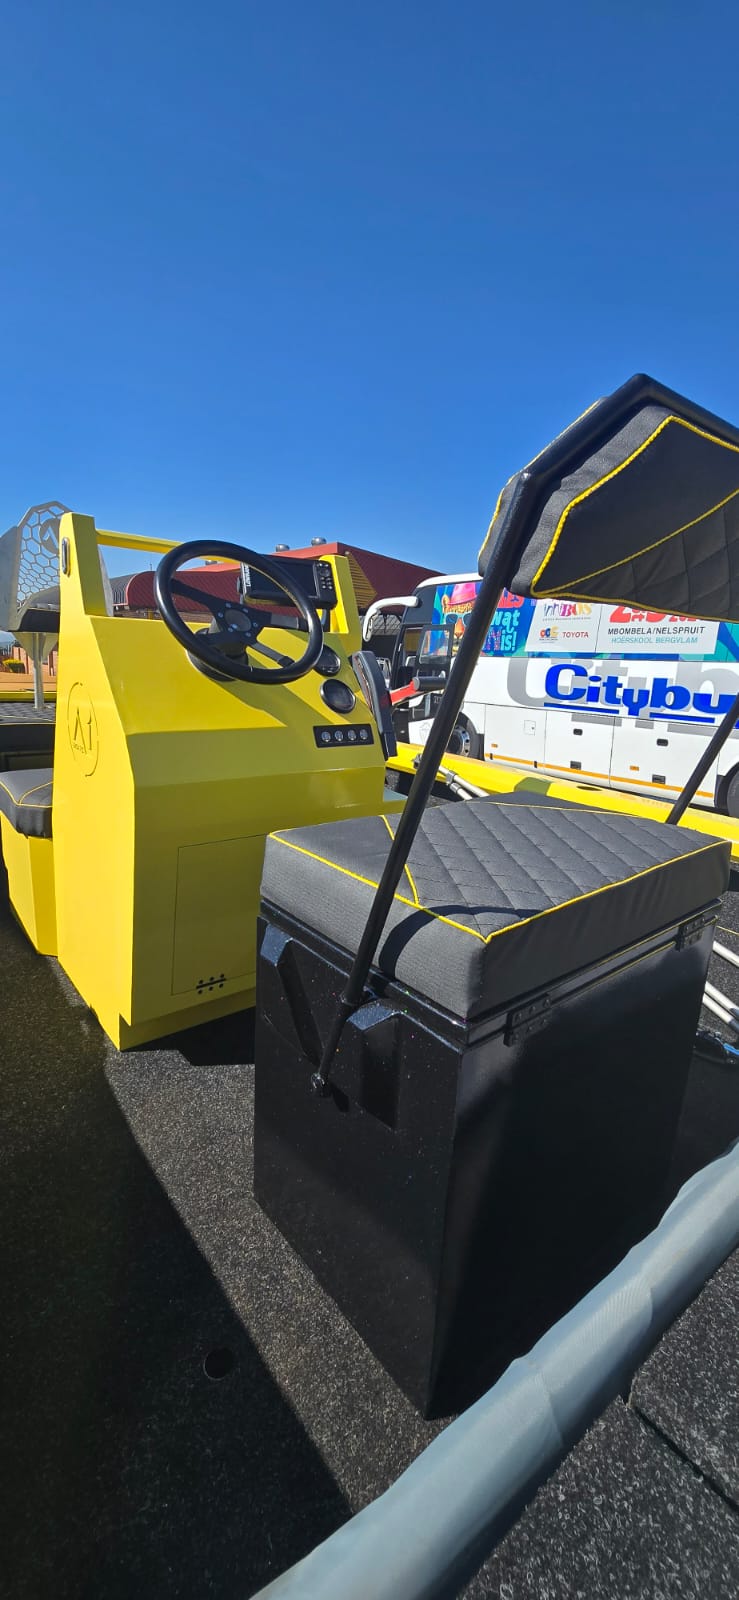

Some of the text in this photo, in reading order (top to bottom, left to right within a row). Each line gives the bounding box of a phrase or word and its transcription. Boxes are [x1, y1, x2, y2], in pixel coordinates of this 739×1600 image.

[608, 626, 705, 635] MBOMBELA/NELSPRUIT
[656, 636, 698, 644] BERGVLAM
[544, 663, 739, 716] Citybu
